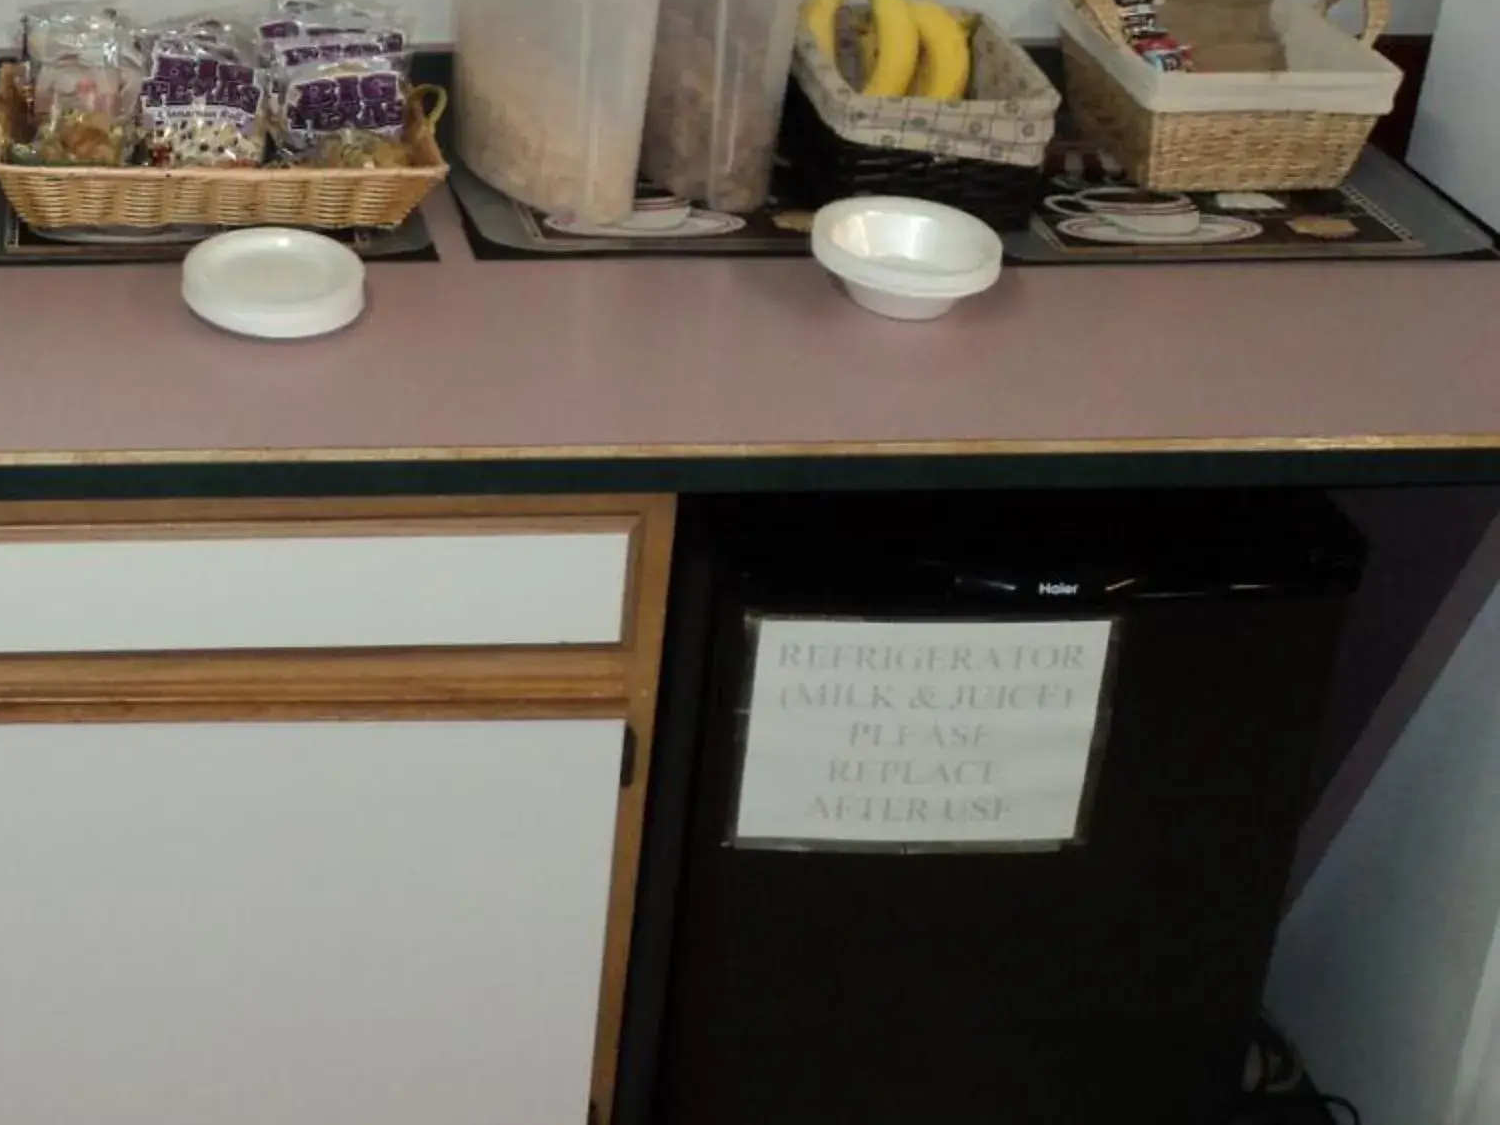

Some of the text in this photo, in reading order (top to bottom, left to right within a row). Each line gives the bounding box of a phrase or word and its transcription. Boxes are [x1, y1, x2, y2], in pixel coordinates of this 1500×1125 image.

[1039, 581, 1080, 596] Haier
[778, 644, 1085, 672] REFRIGERATOR
[908, 686, 937, 710] &
[850, 721, 991, 748] PLEASE
[829, 759, 1002, 786] REPLACE
[806, 795, 1013, 823] AFTER USE
